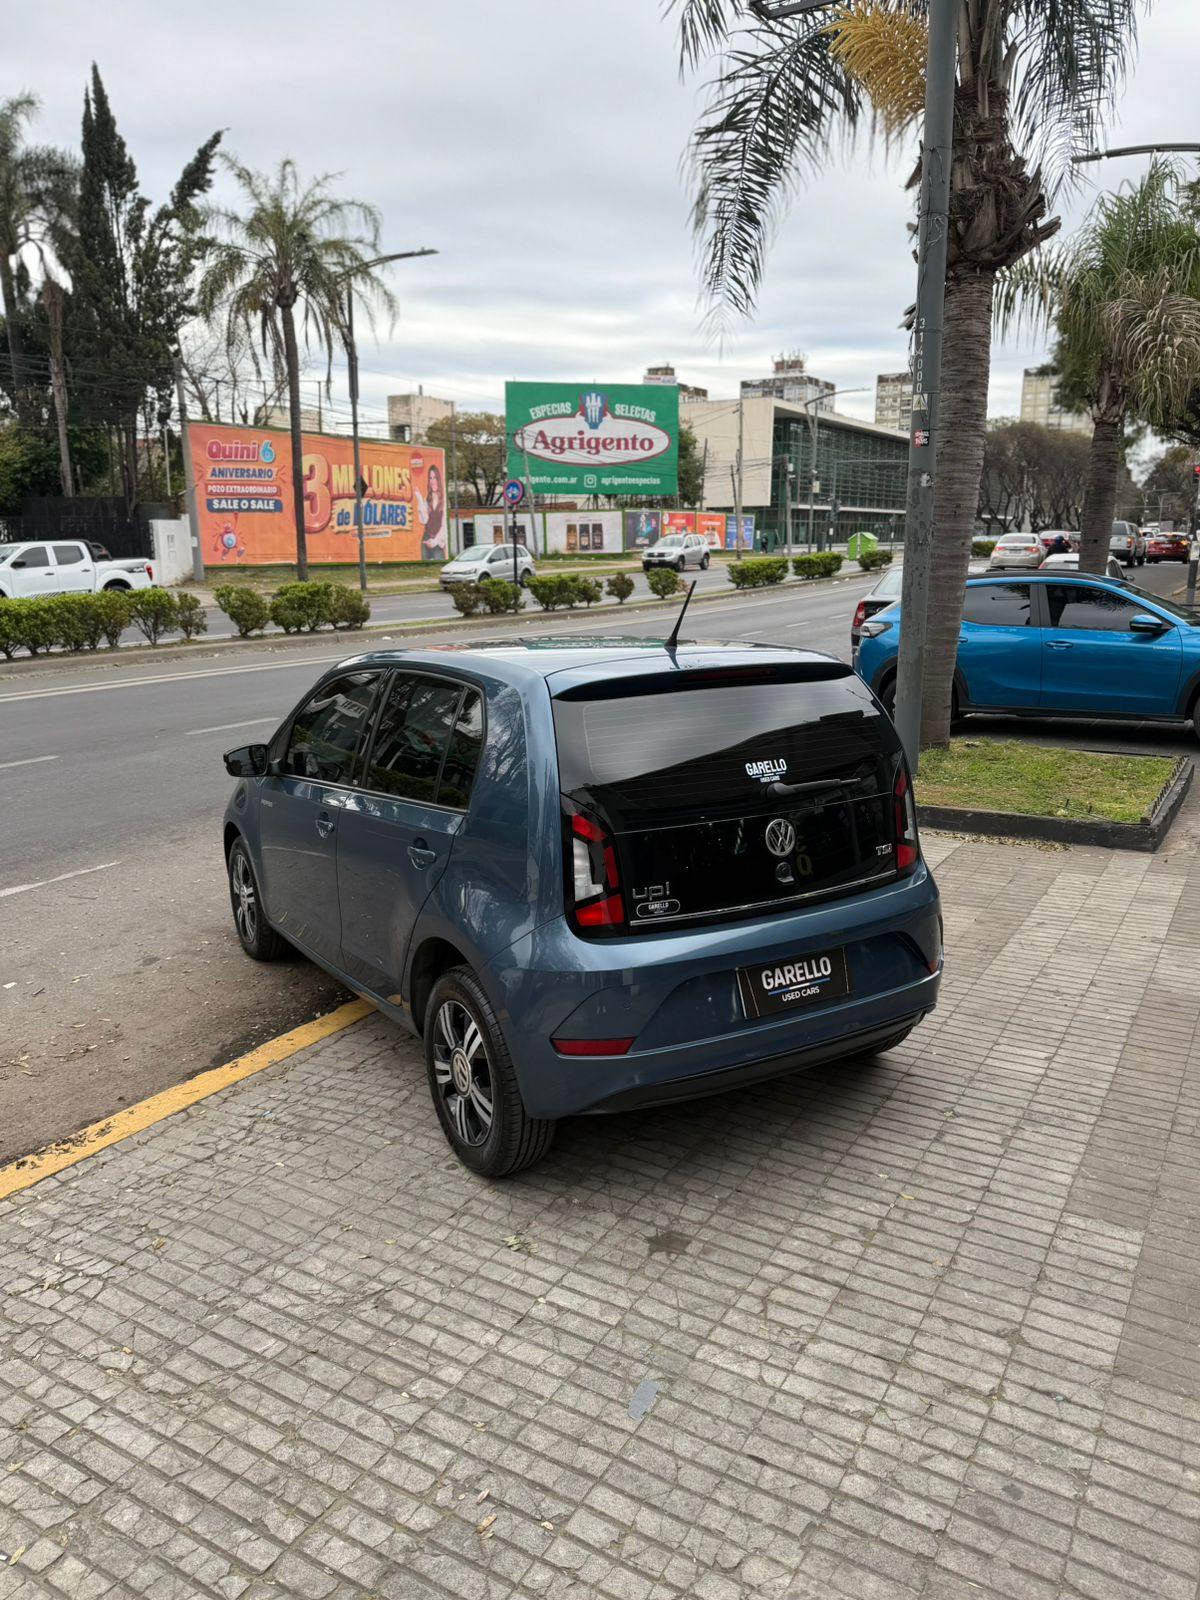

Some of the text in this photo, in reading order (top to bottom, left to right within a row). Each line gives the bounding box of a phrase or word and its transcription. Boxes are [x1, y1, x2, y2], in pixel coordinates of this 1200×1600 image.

[529, 402, 656, 422] ESPECIAS SELECTAS
[207, 440, 275, 463] Quini 6
[532, 430, 654, 455] Agrigento
[210, 467, 273, 479] ANIVERSARIO
[331, 464, 411, 499] MILONES
[207, 485, 277, 494] POZO EXTRAORDINARIO
[301, 453, 332, 534] 3
[213, 499, 275, 510] SALE O SALE
[337, 508, 350, 526] de
[745, 758, 787, 776] GARELLO
[761, 956, 832, 990] GARELLO
[782, 986, 820, 1002] USED CARS
